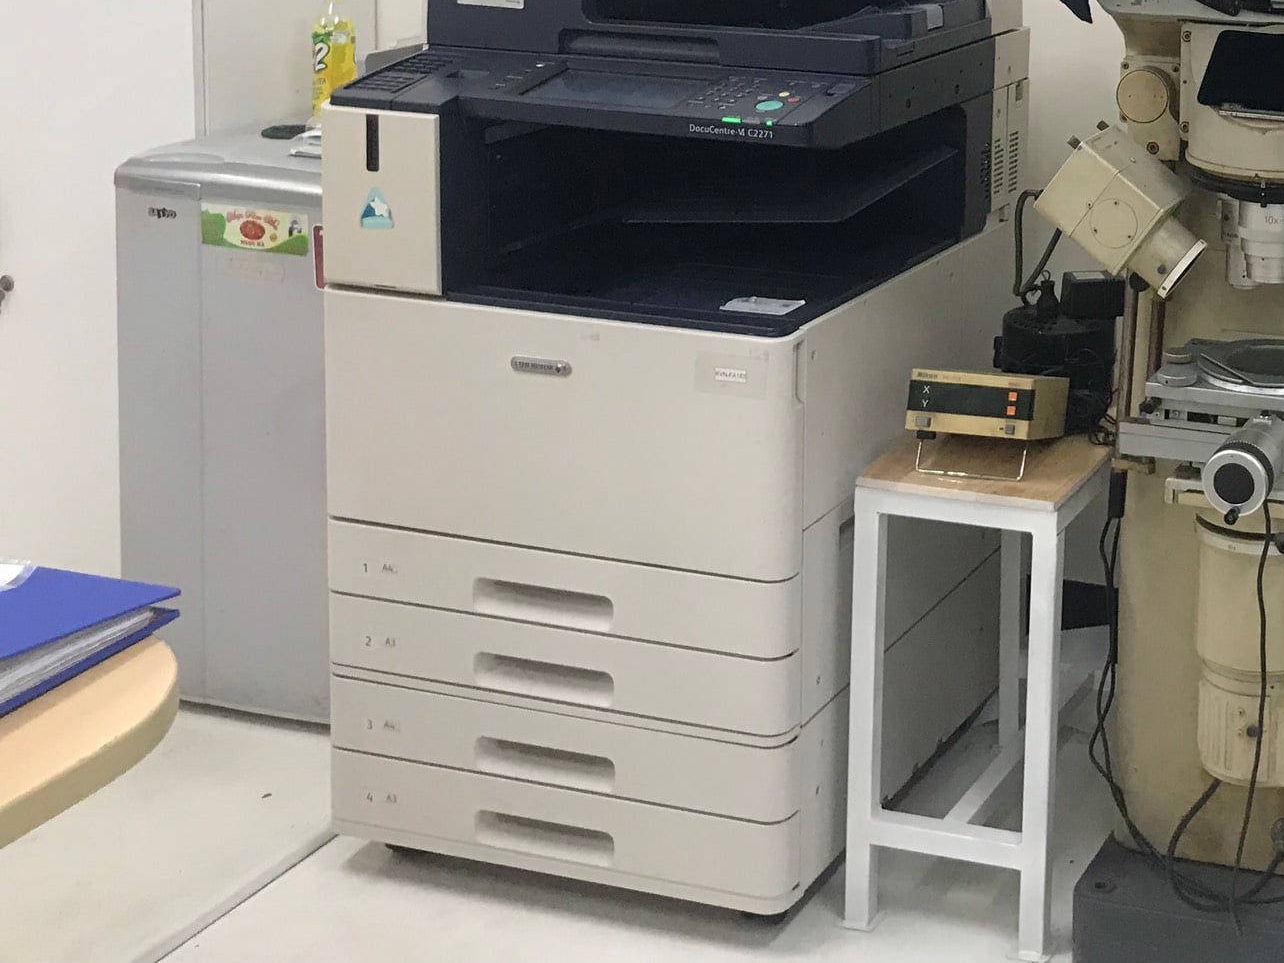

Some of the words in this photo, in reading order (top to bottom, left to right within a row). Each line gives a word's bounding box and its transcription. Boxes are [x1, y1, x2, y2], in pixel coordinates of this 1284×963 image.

[747, 128, 773, 139] C2271
[922, 385, 930, 394] X
[922, 399, 929, 408] Y
